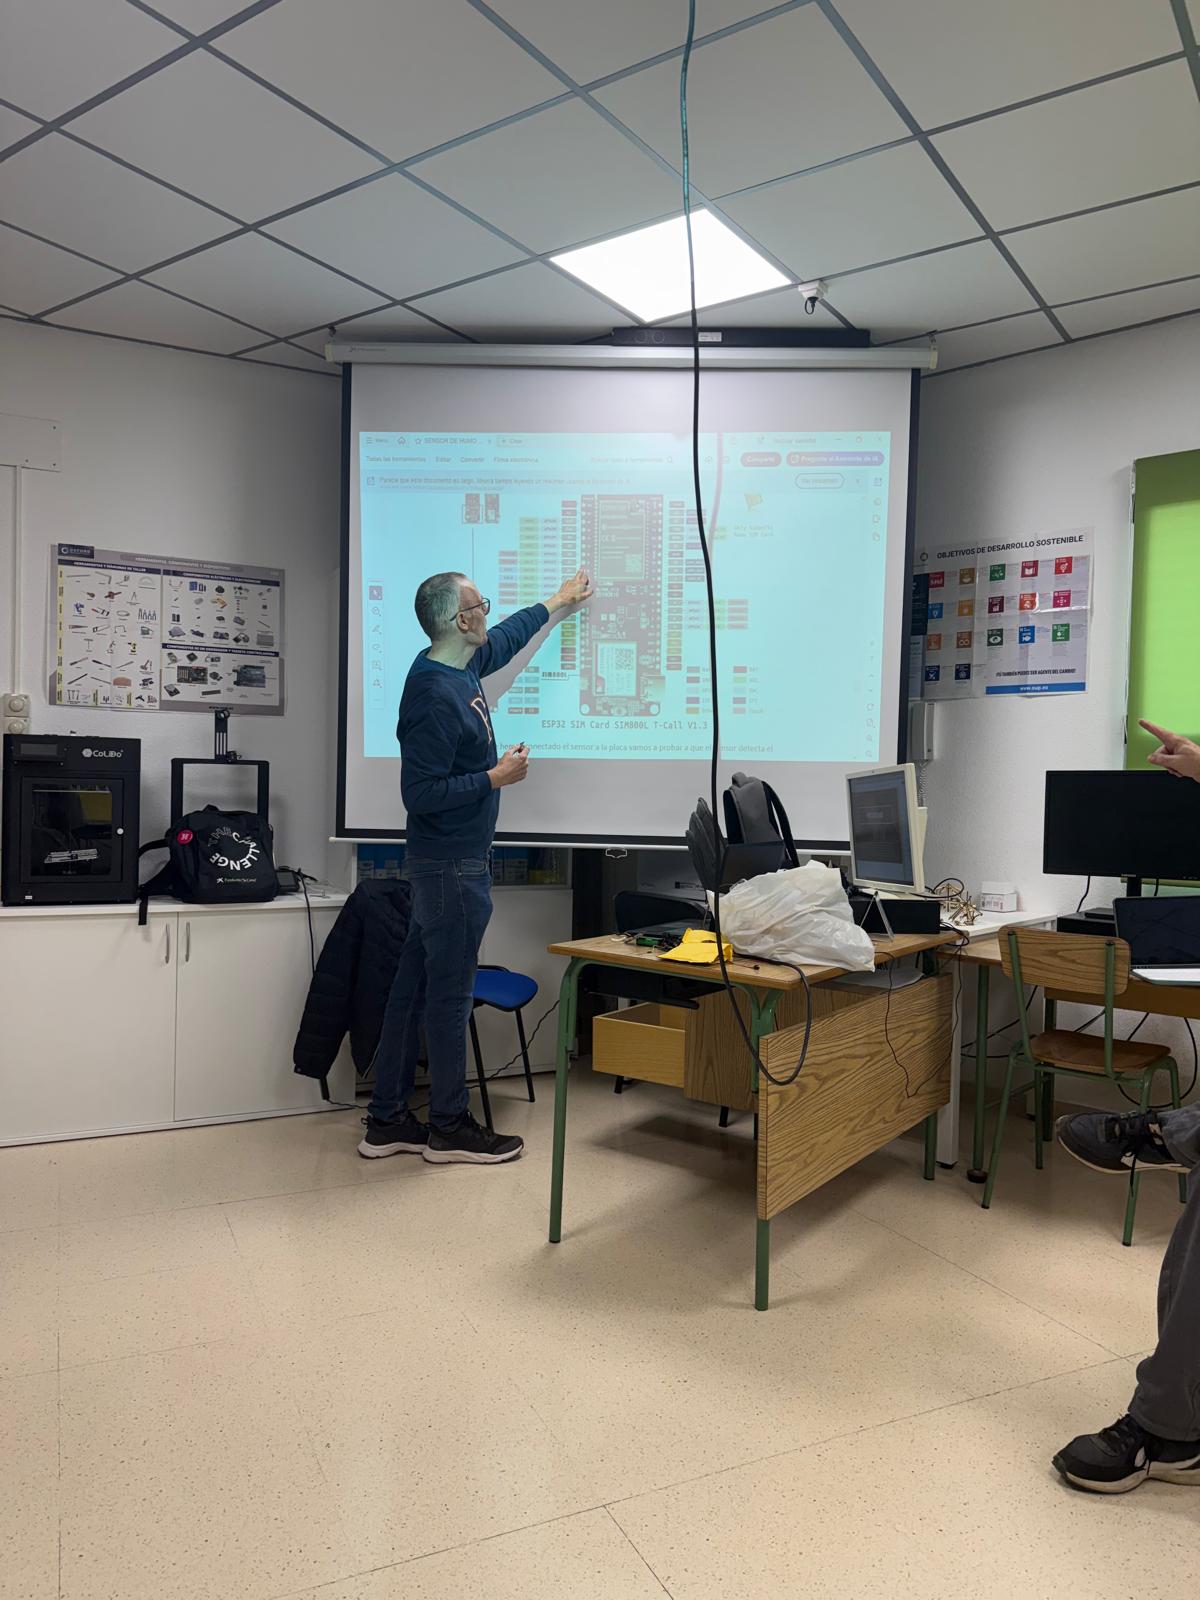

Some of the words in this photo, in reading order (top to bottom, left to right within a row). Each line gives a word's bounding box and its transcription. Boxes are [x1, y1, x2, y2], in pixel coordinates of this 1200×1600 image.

[937, 548, 976, 559] OBJETIVOS
[987, 541, 1034, 552] DESARROLLO
[1036, 535, 1083, 546] SOSTENIBLE
[542, 720, 566, 728] ESP32
[570, 720, 585, 728] SIM
[590, 720, 609, 729] Card
[614, 721, 648, 729] SIM800L
[654, 721, 682, 729] T-Call
[688, 721, 708, 729] V1.3
[659, 744, 682, 752] probar
